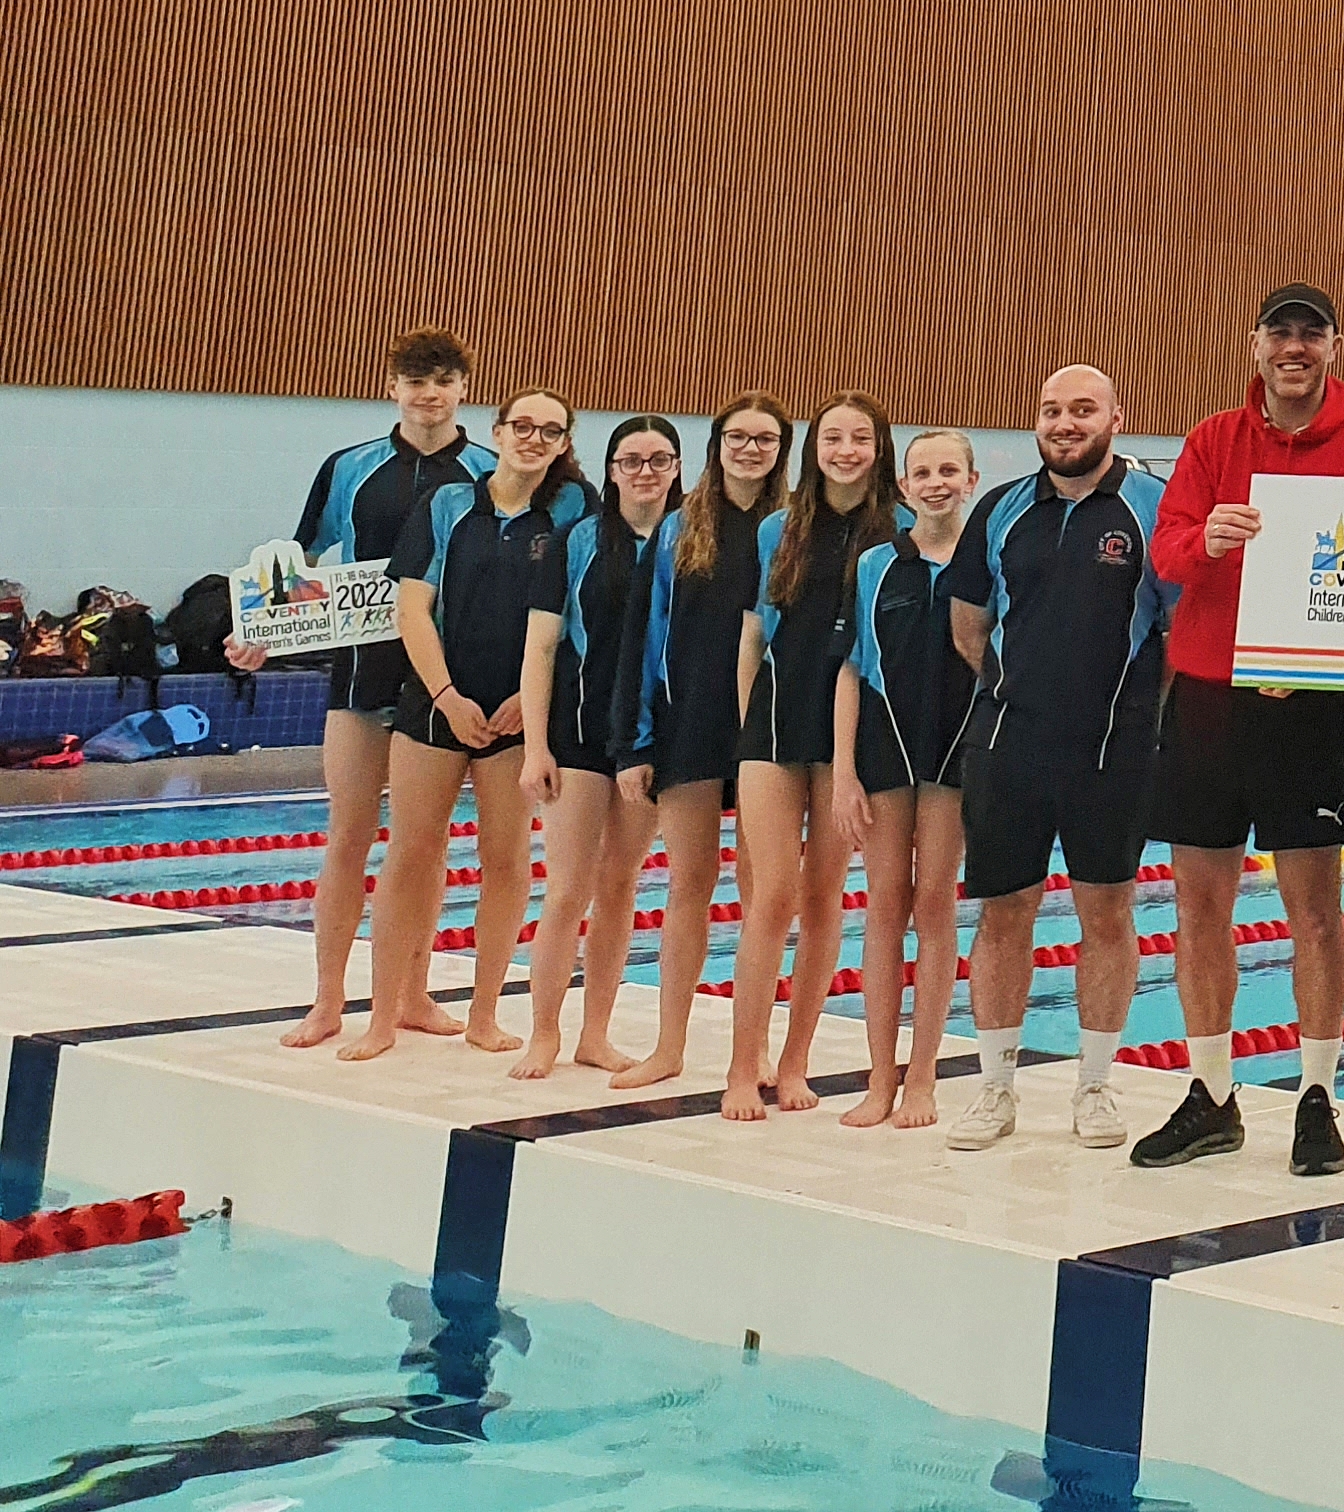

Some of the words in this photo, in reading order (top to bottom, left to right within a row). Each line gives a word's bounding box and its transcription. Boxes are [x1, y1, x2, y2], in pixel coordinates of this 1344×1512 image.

[1106, 538, 1125, 555] C
[336, 579, 395, 611] 2022
[240, 601, 330, 624] COVENTRY
[242, 614, 331, 640] International
